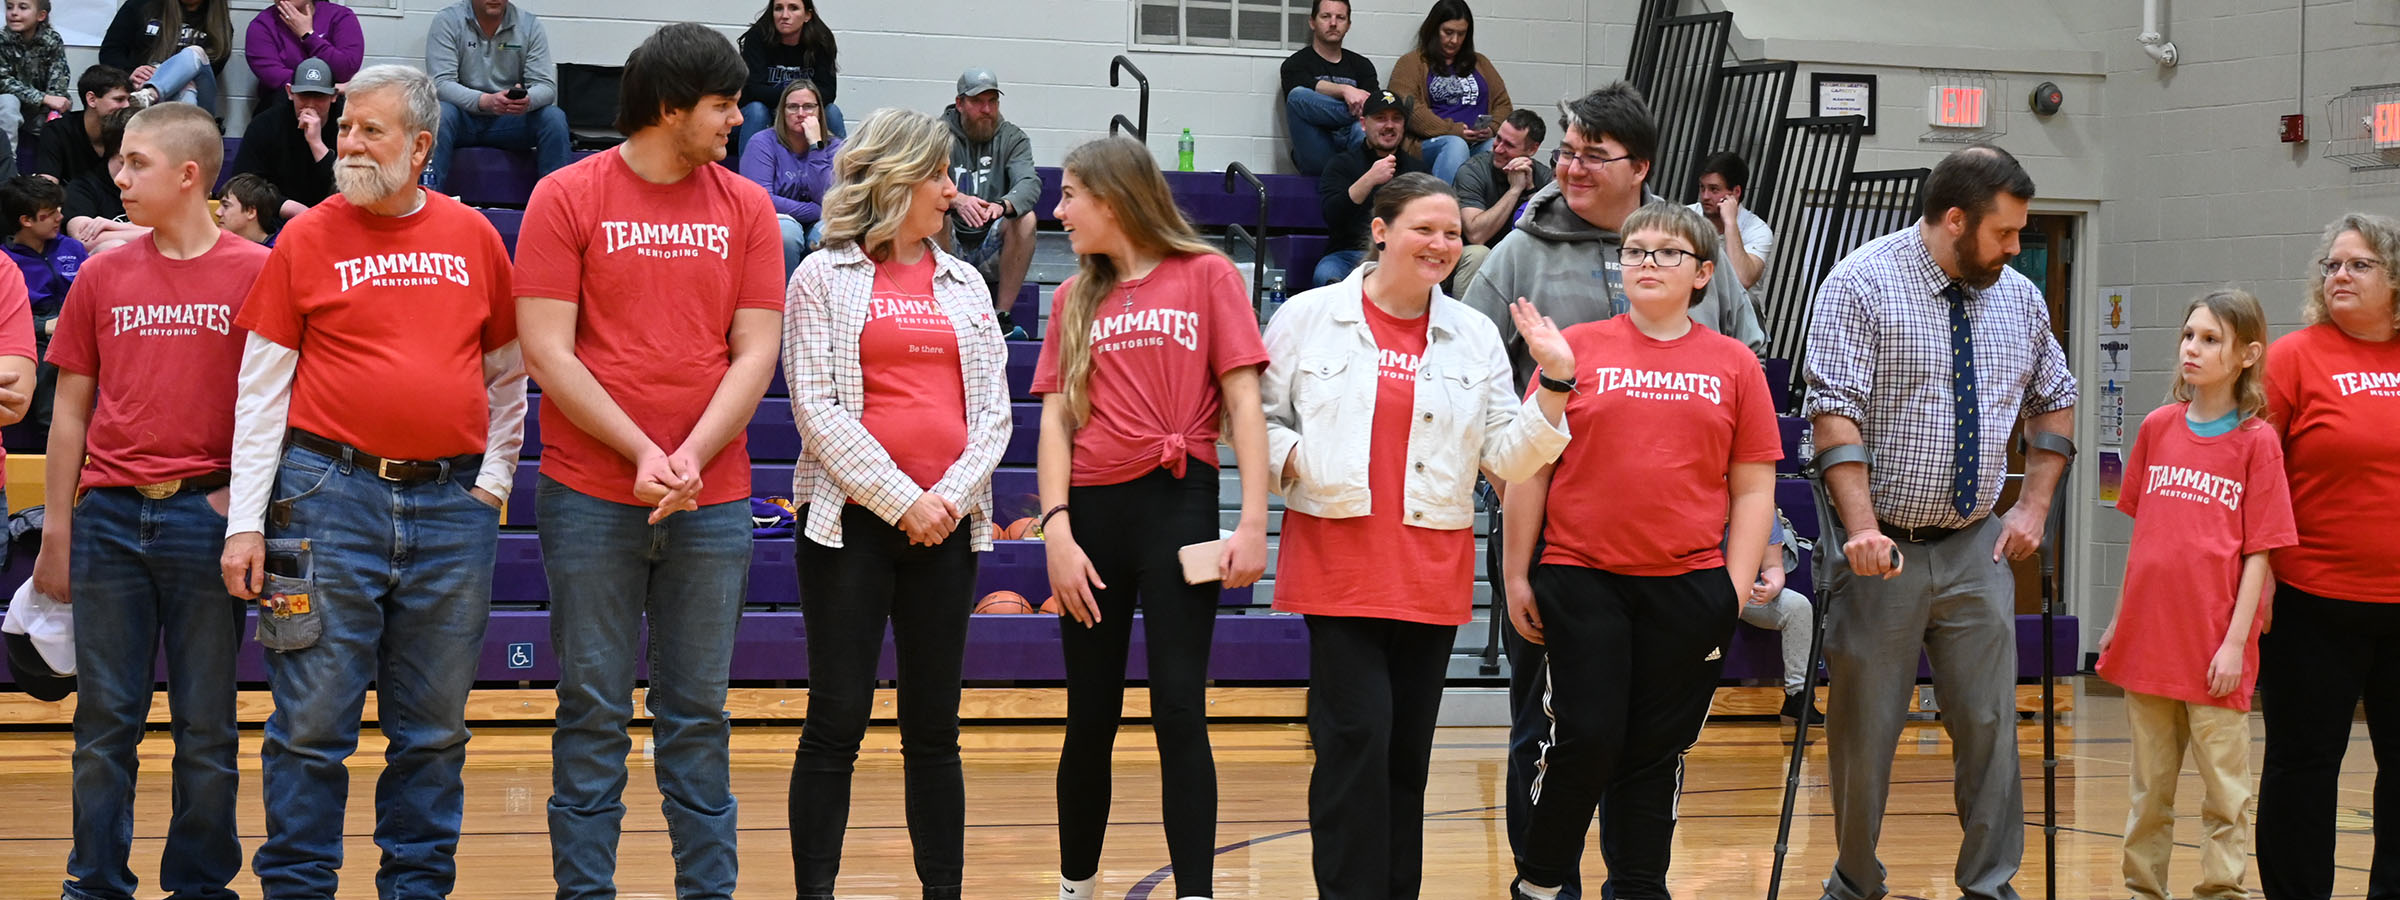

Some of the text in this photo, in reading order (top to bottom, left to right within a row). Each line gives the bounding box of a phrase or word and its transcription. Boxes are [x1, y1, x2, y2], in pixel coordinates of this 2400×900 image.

[1941, 88, 1984, 124] EXIT
[601, 221, 729, 260] TEAMMATES
[638, 247, 699, 259] MENTORING
[334, 252, 470, 293] TEAMMATES
[372, 277, 439, 287] MENTORING
[111, 303, 231, 337] TEAMMATES
[139, 328, 198, 336] MENTORING
[909, 345, 945, 354] Be there.
[1098, 337, 1165, 354] MENTORING
[1596, 367, 1721, 405] TEAMMATES
[2332, 372, 2400, 397] TEAMM
[1626, 389, 1690, 401] MENTORING
[2160, 489, 2210, 504] MENTORING
